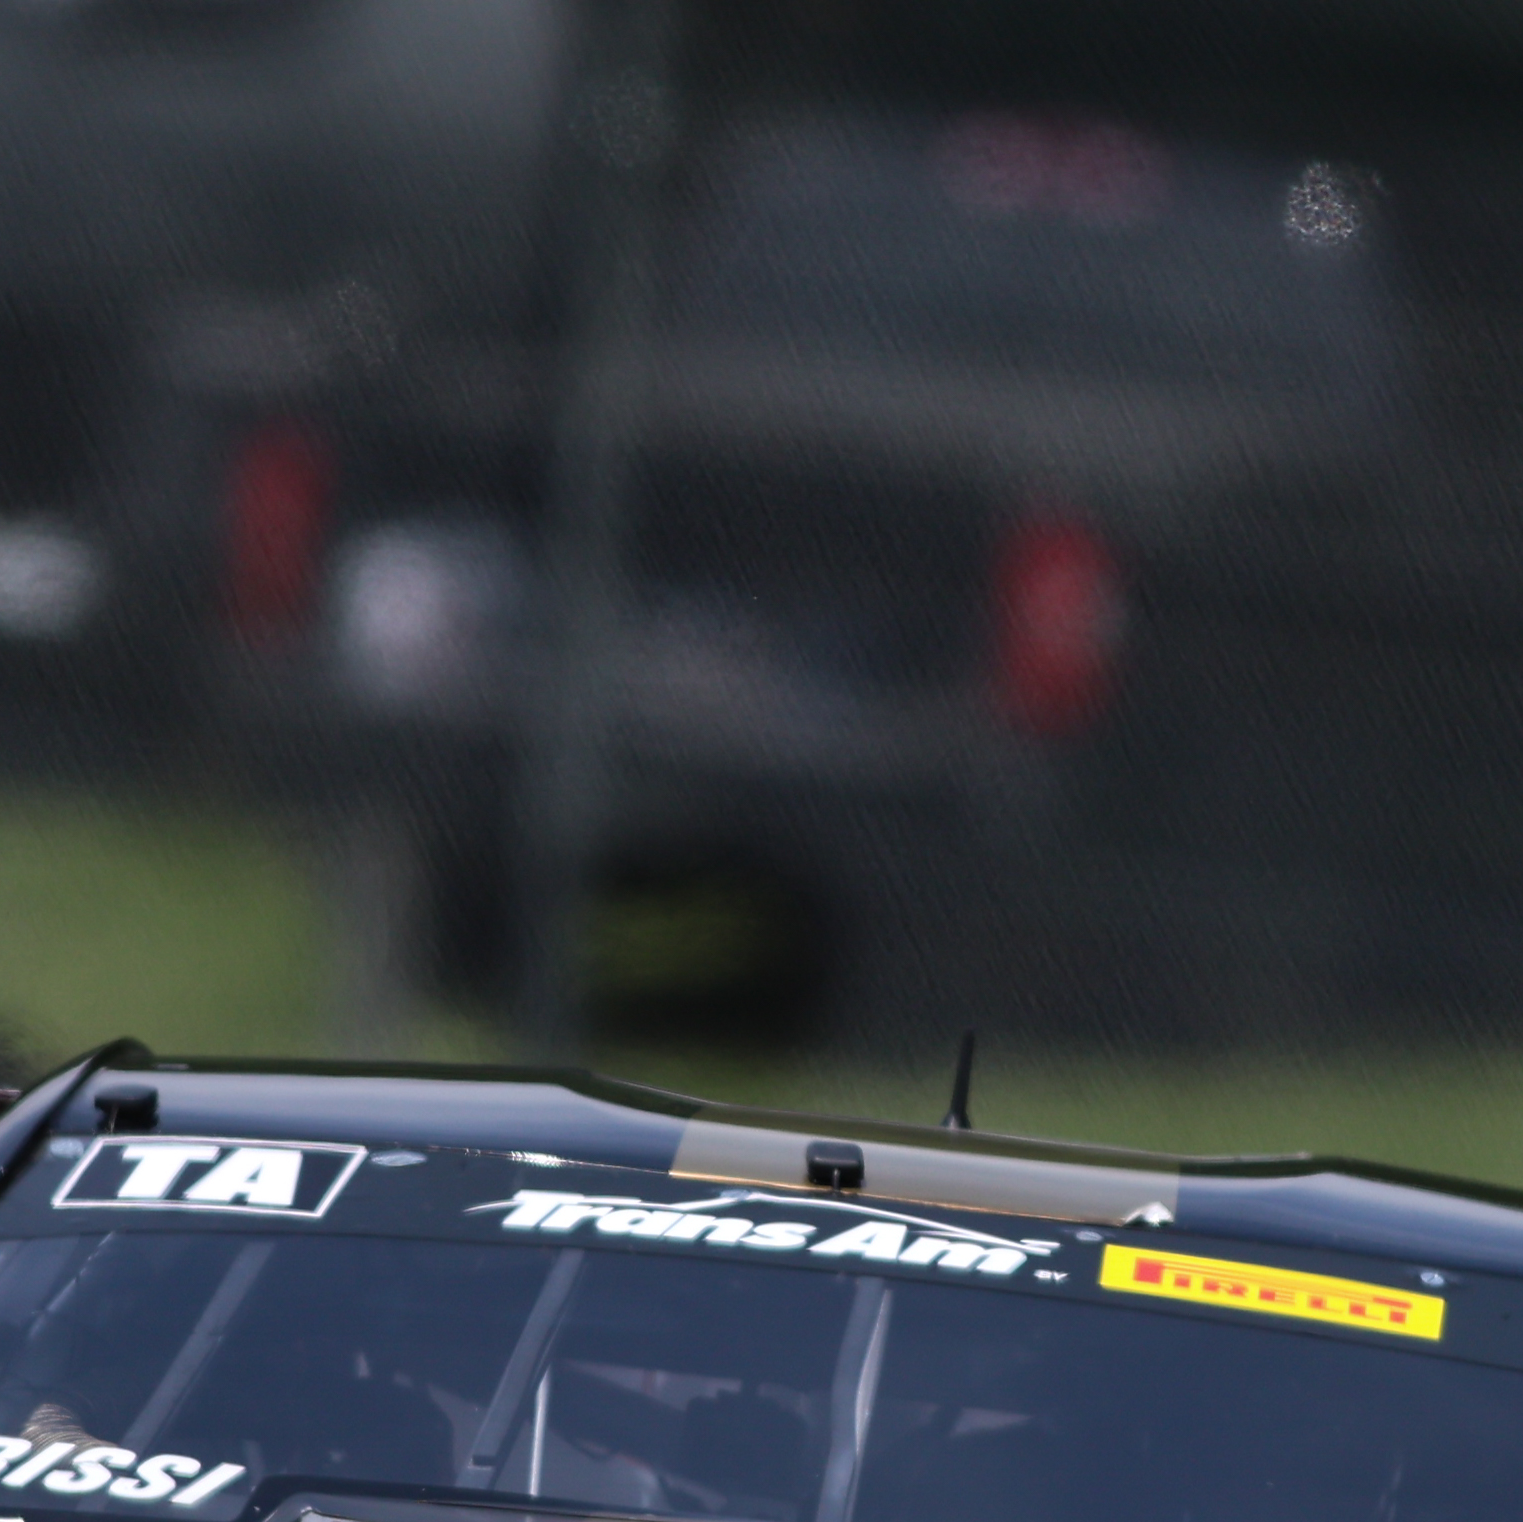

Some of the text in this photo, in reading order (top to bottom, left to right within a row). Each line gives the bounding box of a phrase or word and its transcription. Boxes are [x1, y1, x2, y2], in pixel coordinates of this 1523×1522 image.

[117, 1145, 303, 1207] TA
[501, 1189, 1030, 1275] Trans Am
[1133, 1257, 1412, 1324] PIRELLI
